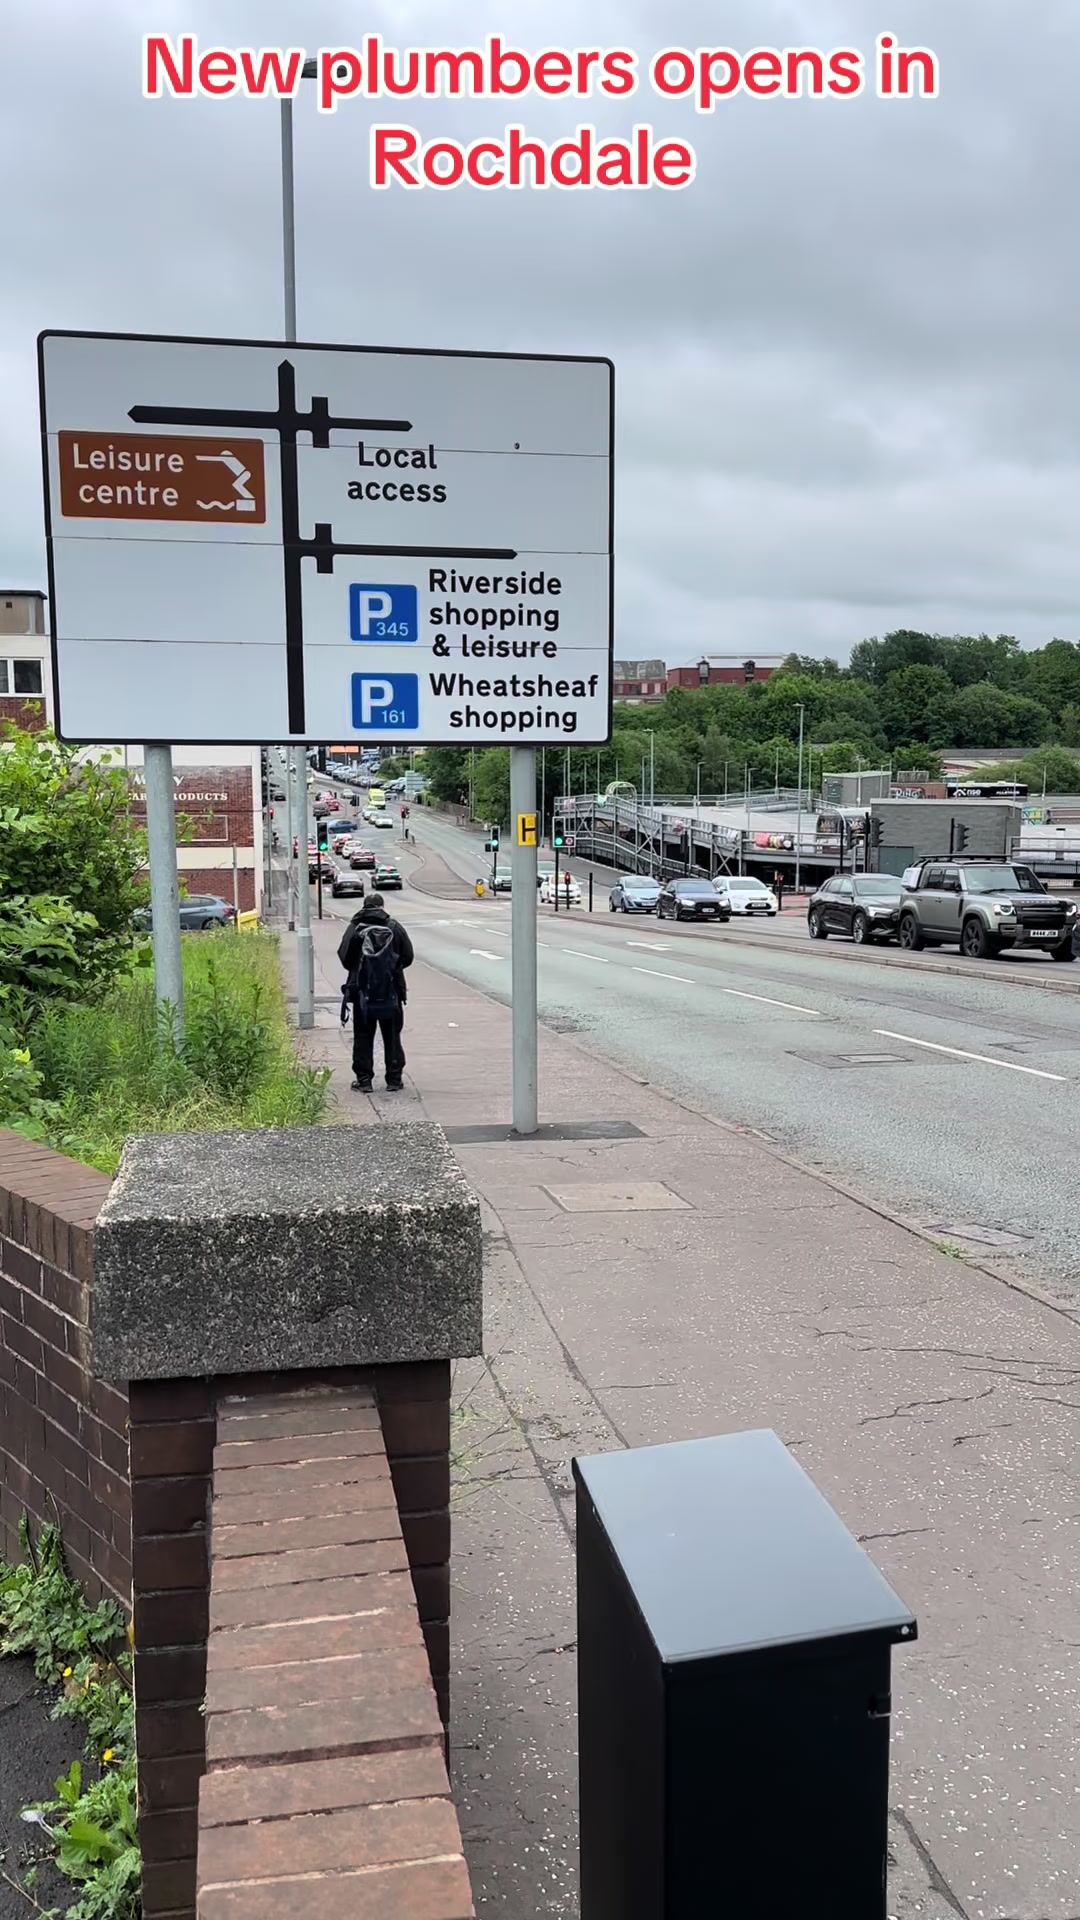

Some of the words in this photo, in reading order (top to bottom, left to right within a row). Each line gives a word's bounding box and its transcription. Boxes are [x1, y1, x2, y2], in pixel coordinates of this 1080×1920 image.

[73, 443, 184, 473] Leisure
[358, 441, 438, 470] Local
[79, 481, 179, 506] centre
[347, 481, 447, 503] access
[429, 568, 562, 596] Riverside
[359, 591, 393, 635] P
[376, 621, 409, 636] 345
[429, 601, 559, 632] shopping
[432, 633, 451, 657] &
[462, 633, 558, 659] leisure
[429, 673, 599, 698] Wheatsheaf
[361, 679, 395, 723] P
[381, 710, 406, 723] 161
[449, 704, 577, 733] shopping
[173, 792, 228, 801] RODUCTS
